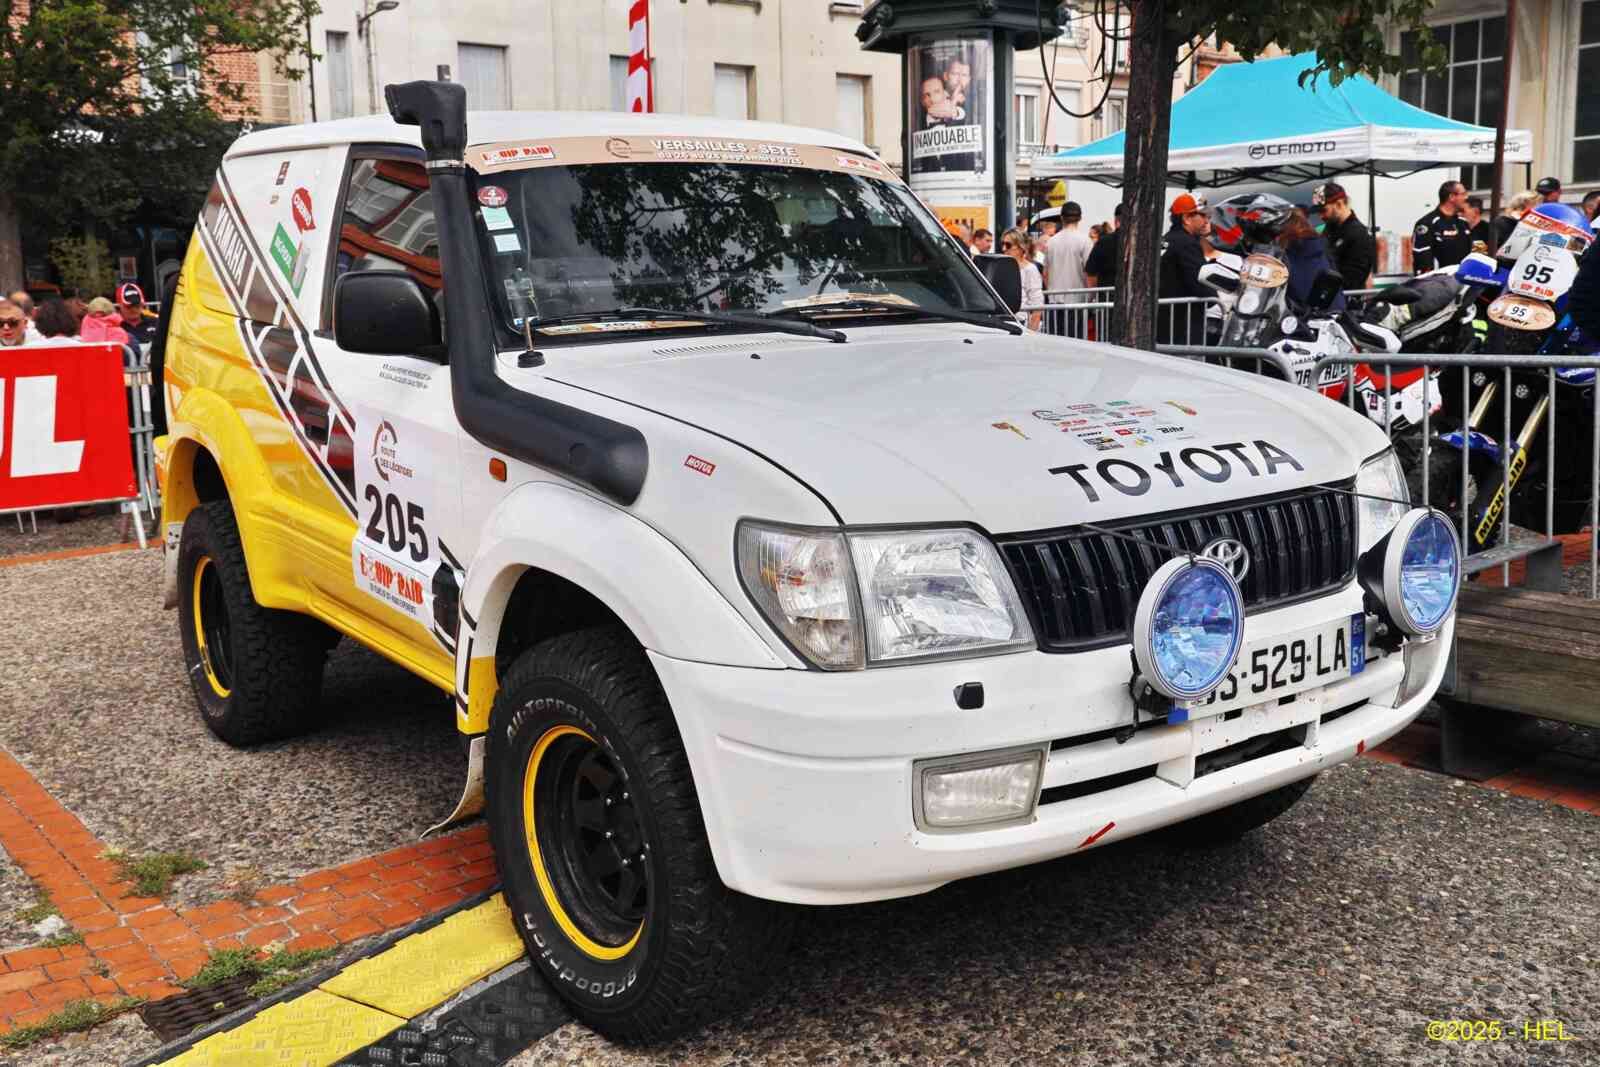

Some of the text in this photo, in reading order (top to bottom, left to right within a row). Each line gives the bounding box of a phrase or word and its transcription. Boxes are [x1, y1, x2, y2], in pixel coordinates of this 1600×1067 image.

[653, 138, 747, 153] VERSAILLES
[914, 127, 978, 149] INAVOUABLE
[1266, 140, 1337, 156] CFMOTO
[211, 202, 248, 288] YAMAHA
[1522, 263, 1555, 285] 95
[1510, 305, 1528, 318] 95
[0, 374, 86, 479] L
[1049, 439, 1304, 503] TOYOTA
[364, 483, 430, 562] 205
